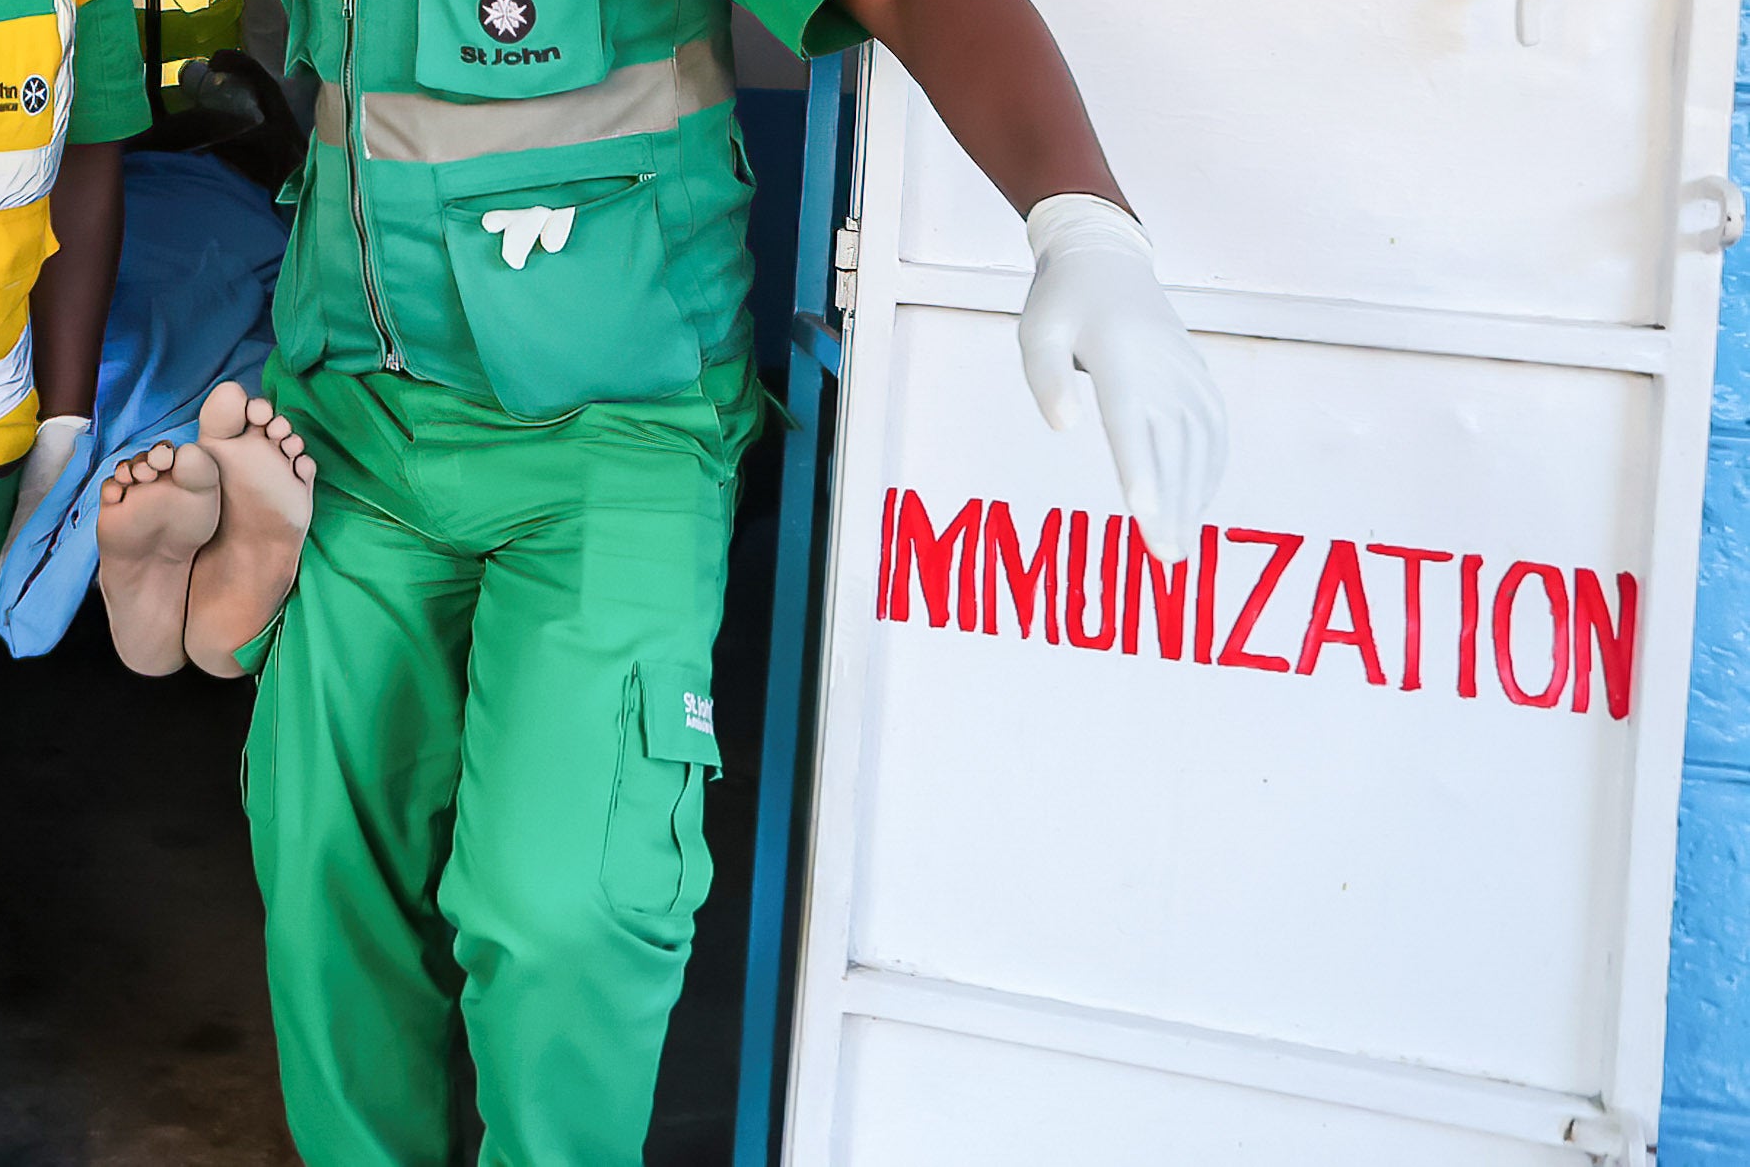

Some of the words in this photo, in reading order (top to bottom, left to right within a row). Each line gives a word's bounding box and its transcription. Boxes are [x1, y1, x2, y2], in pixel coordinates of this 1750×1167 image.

[460, 46, 487, 66] St
[491, 46, 561, 66] John
[876, 487, 1638, 720] IMMUNIZATION
